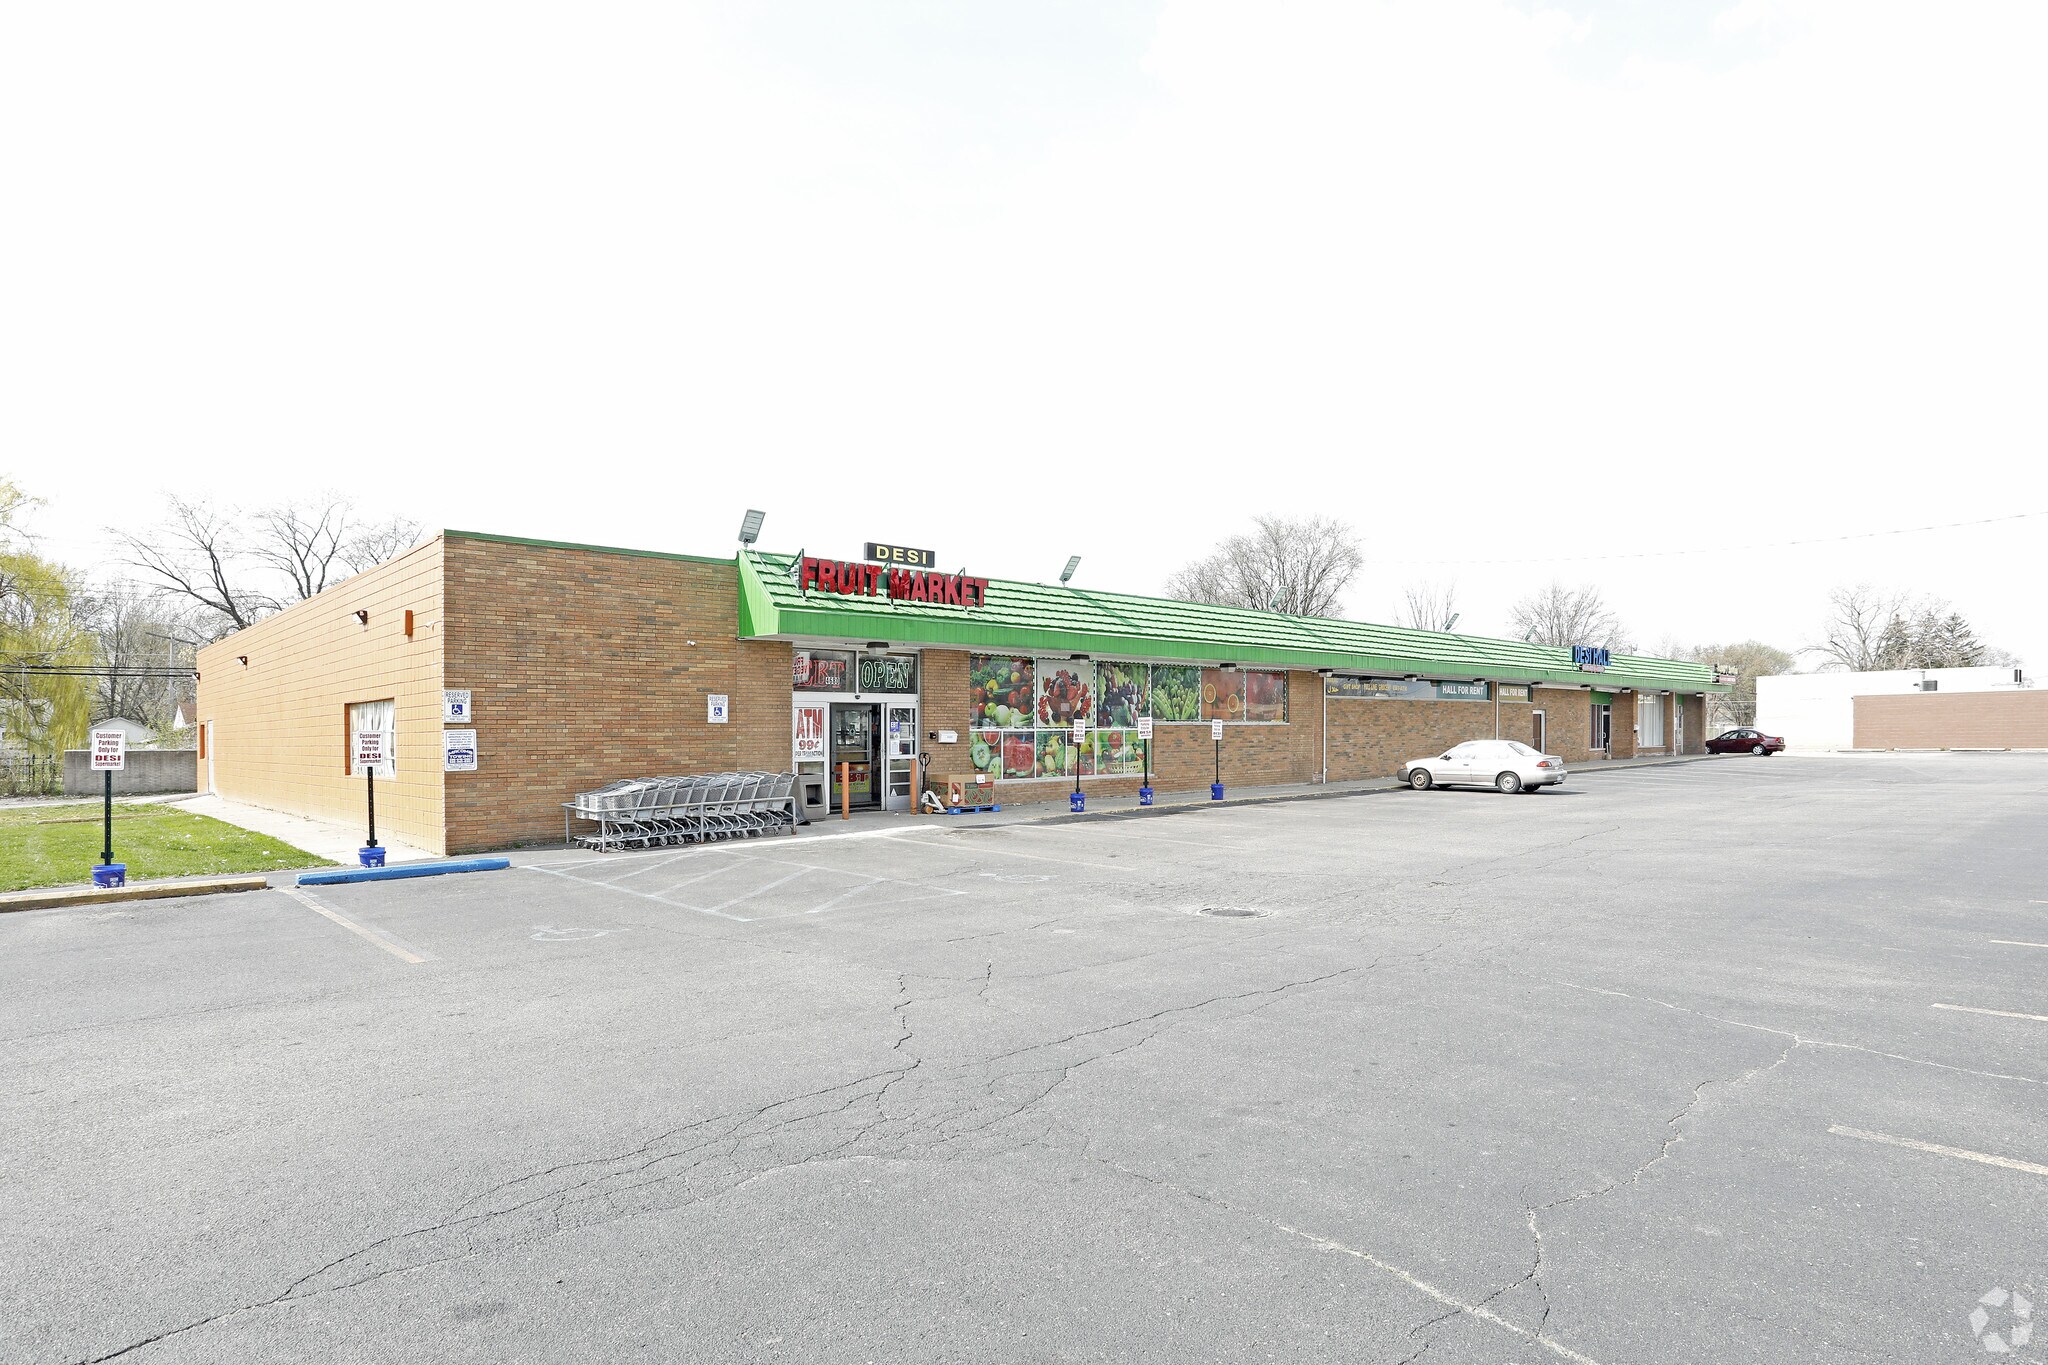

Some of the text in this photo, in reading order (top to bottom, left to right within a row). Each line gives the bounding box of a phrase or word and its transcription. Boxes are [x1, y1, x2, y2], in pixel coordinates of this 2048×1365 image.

[876, 545, 927, 564] DESI
[802, 556, 989, 608] FRUIT MARKET
[1573, 645, 1593, 664] DESI
[861, 660, 909, 689] OPEN
[1442, 685, 1484, 695] HALL FOR RENT
[1499, 688, 1528, 697] HALL FOR RENT
[796, 708, 823, 739] ATM
